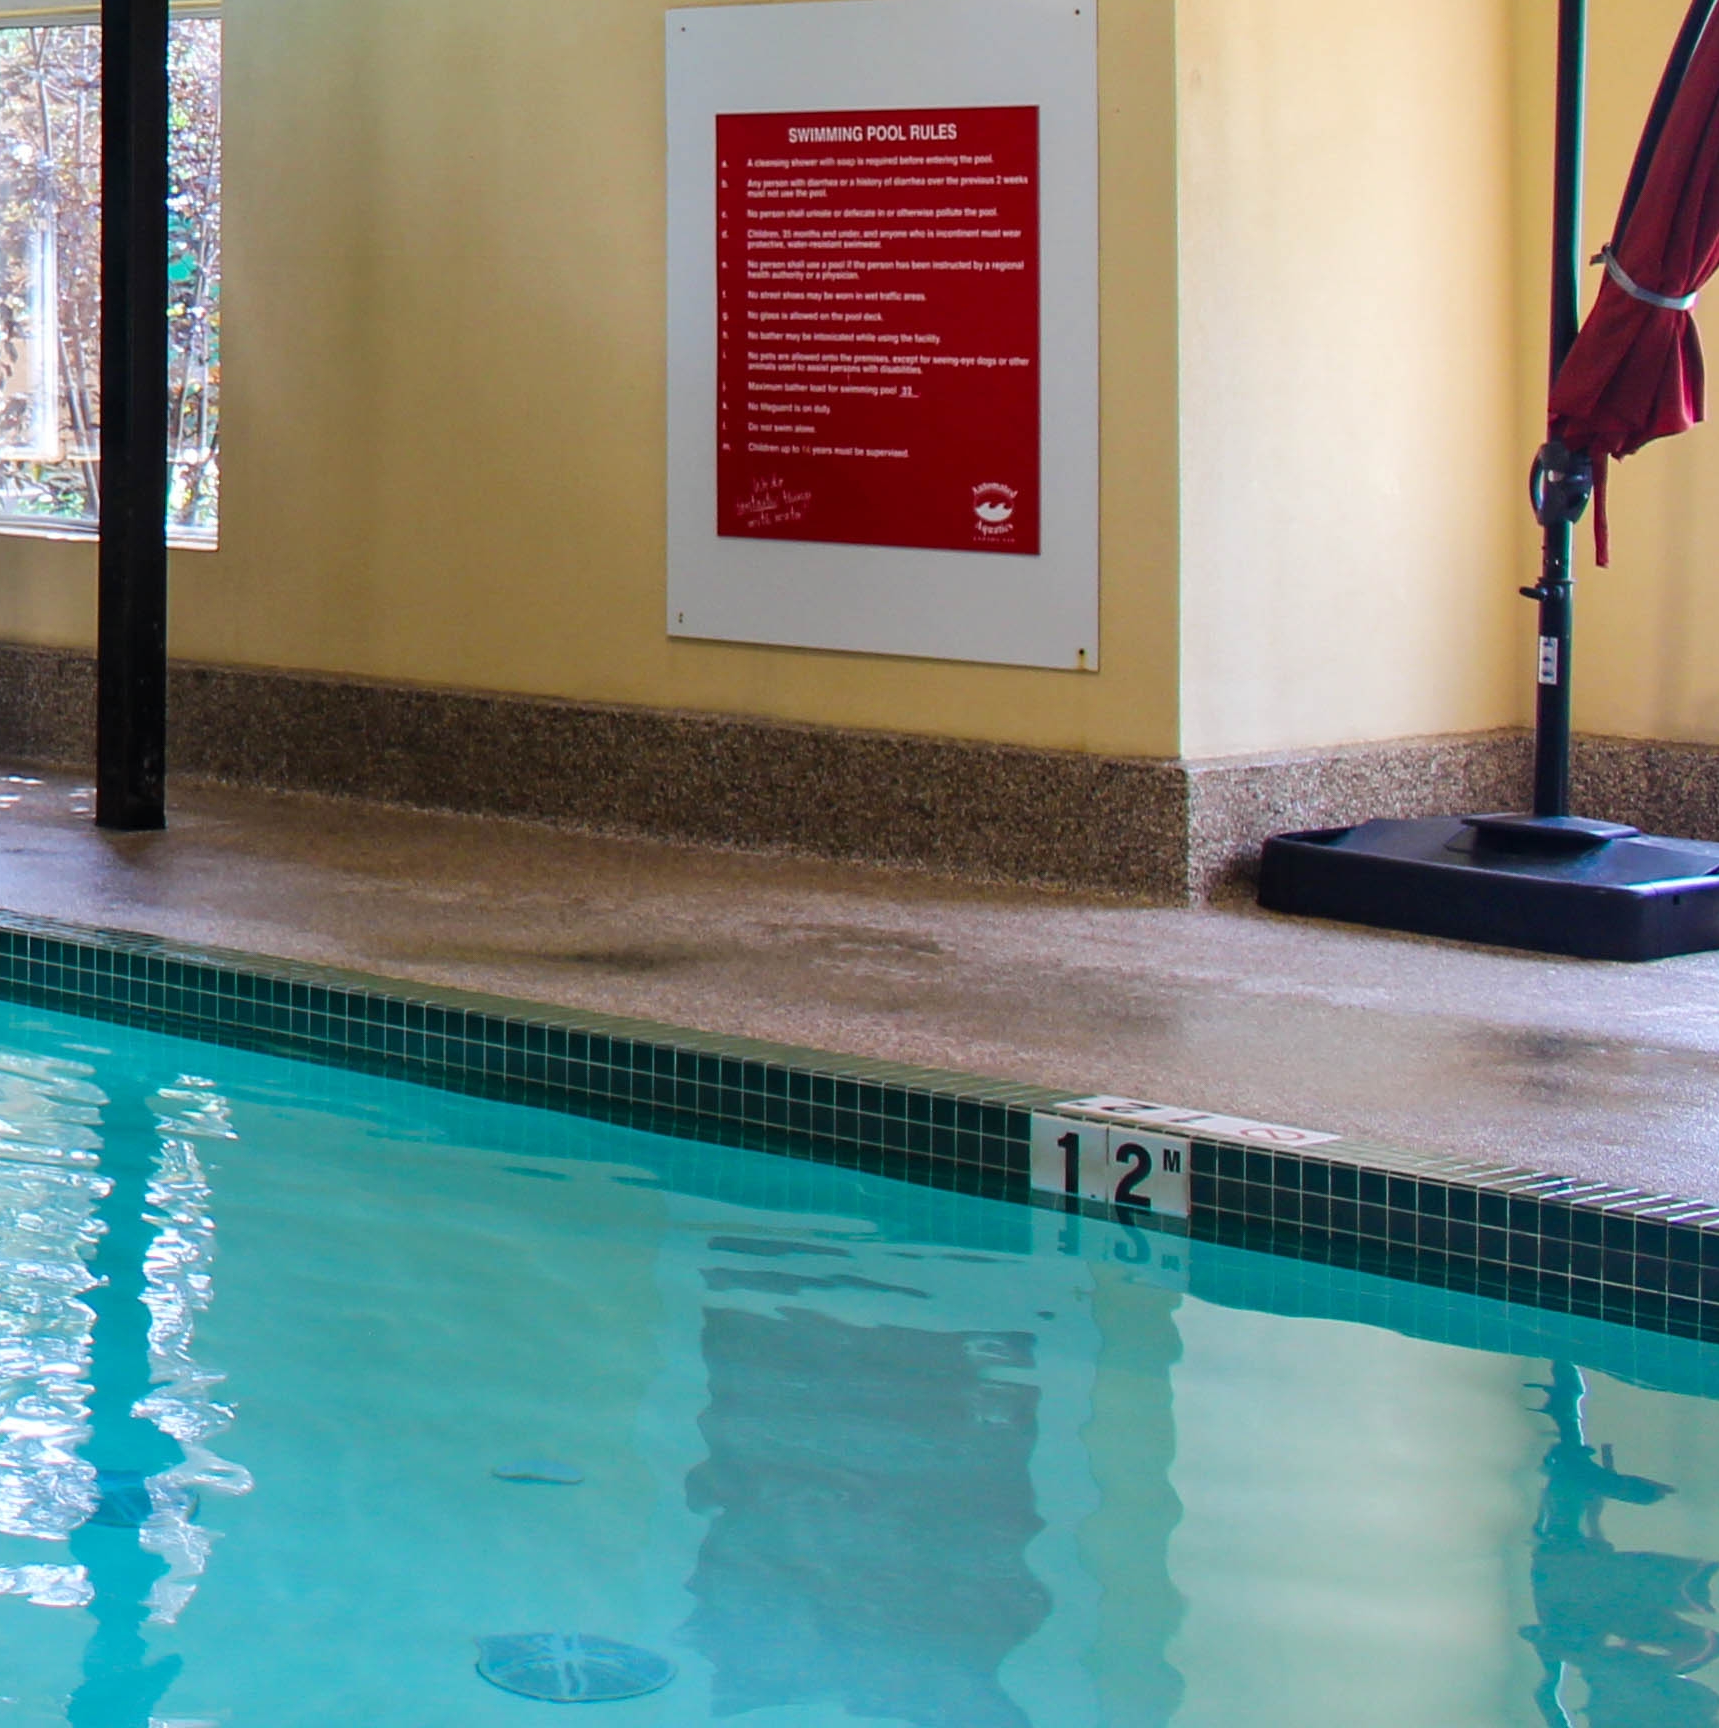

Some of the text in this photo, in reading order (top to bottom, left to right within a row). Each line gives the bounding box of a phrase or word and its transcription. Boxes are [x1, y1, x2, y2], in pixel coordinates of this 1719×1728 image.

[788, 124, 958, 143] SWIMMING POOL RULES
